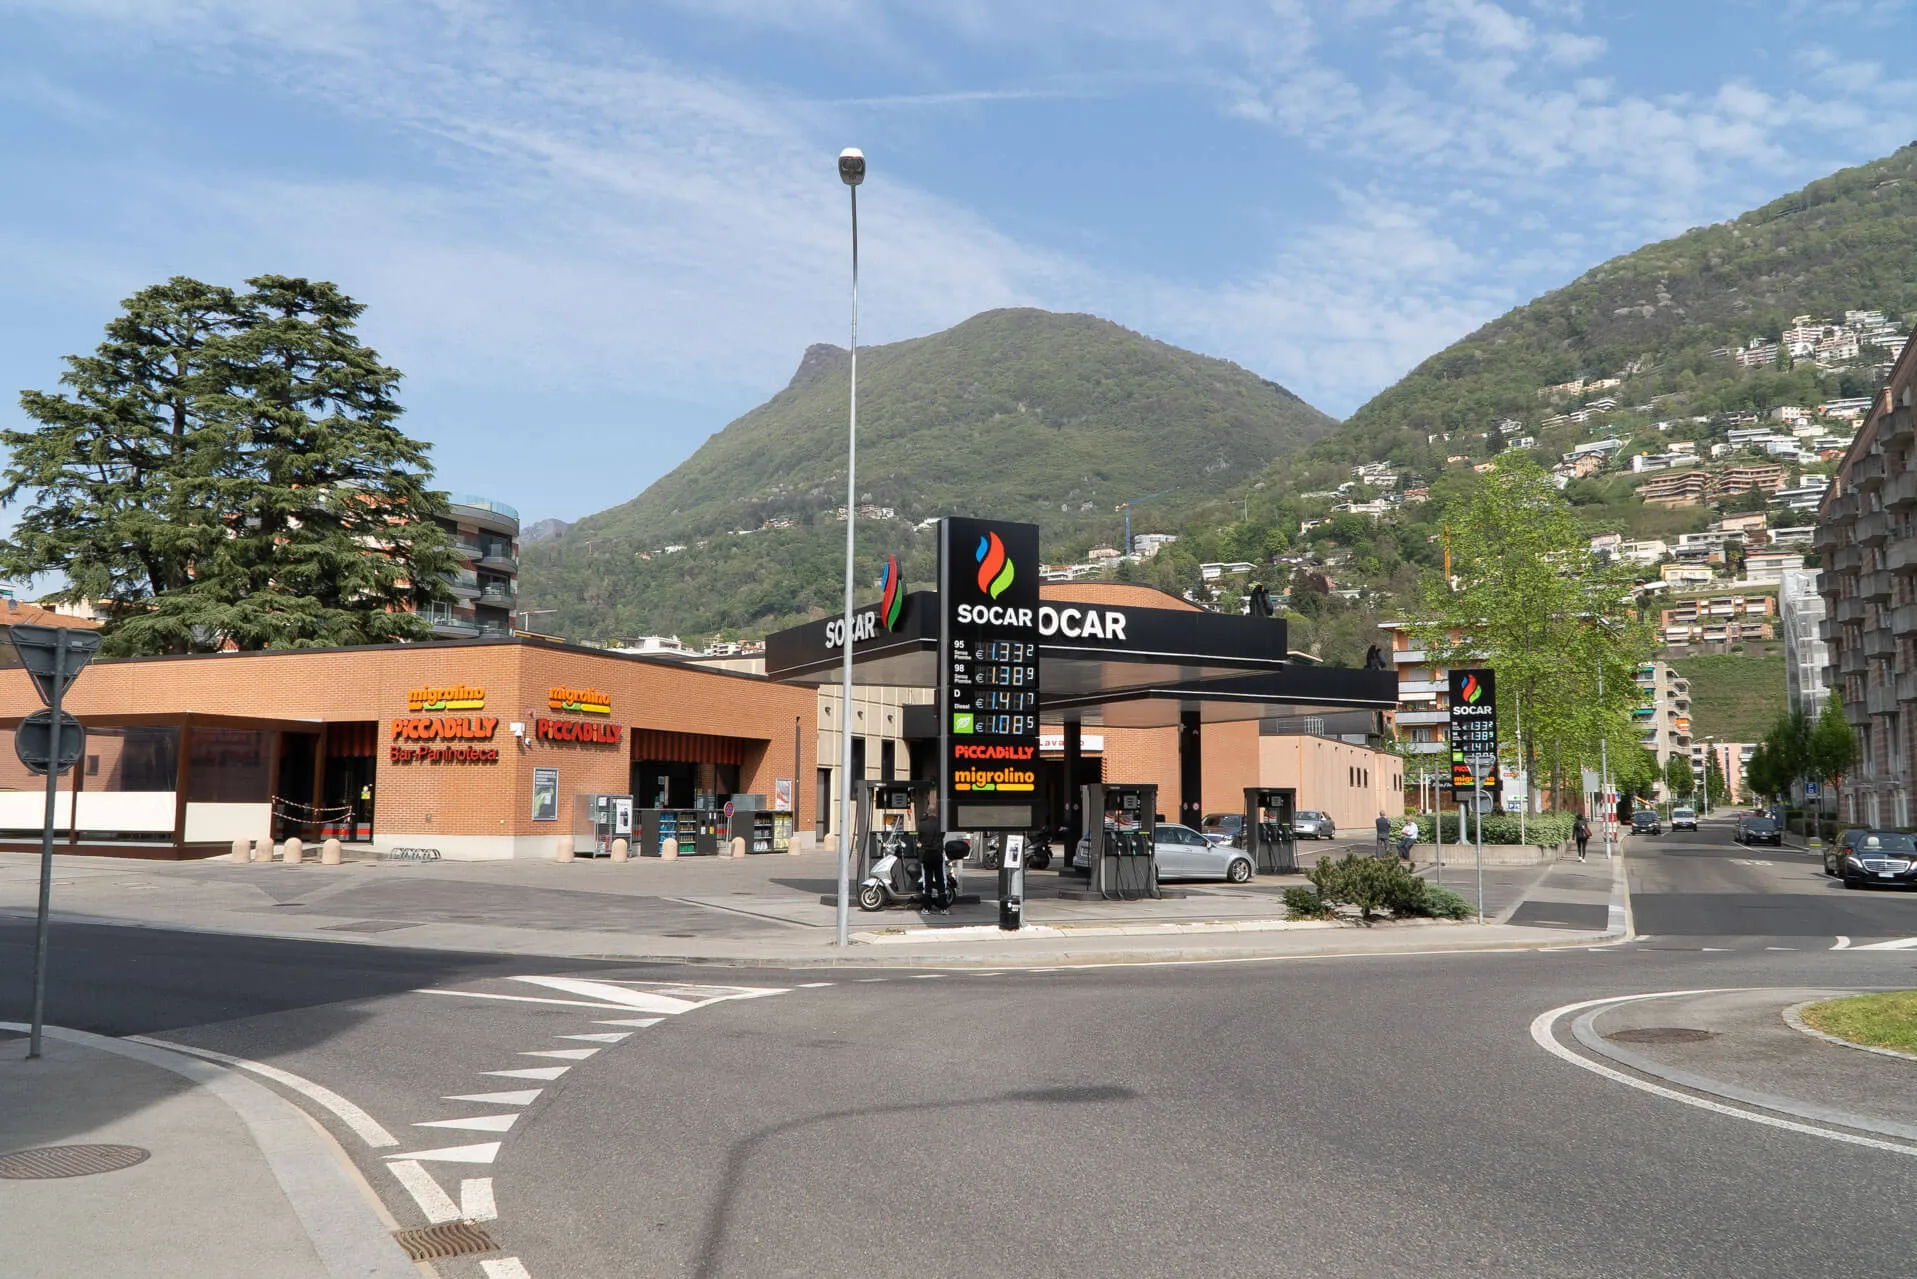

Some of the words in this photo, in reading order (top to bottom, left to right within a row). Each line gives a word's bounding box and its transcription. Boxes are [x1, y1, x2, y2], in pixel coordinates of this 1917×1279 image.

[957, 603, 1033, 627] SOCAR
[825, 611, 876, 649] SOAR
[953, 640, 965, 649] 95
[975, 649, 985, 660] €
[953, 664, 965, 672] 98
[975, 673, 985, 683] €
[408, 683, 485, 706] migrolino
[549, 684, 611, 706] migrolino
[953, 689, 961, 697] D
[975, 698, 985, 709] €
[1453, 705, 1492, 715] SOCAR
[975, 722, 984, 733] €
[390, 745, 498, 761] Bar-Paninoteca
[955, 766, 1035, 787] migrolino
